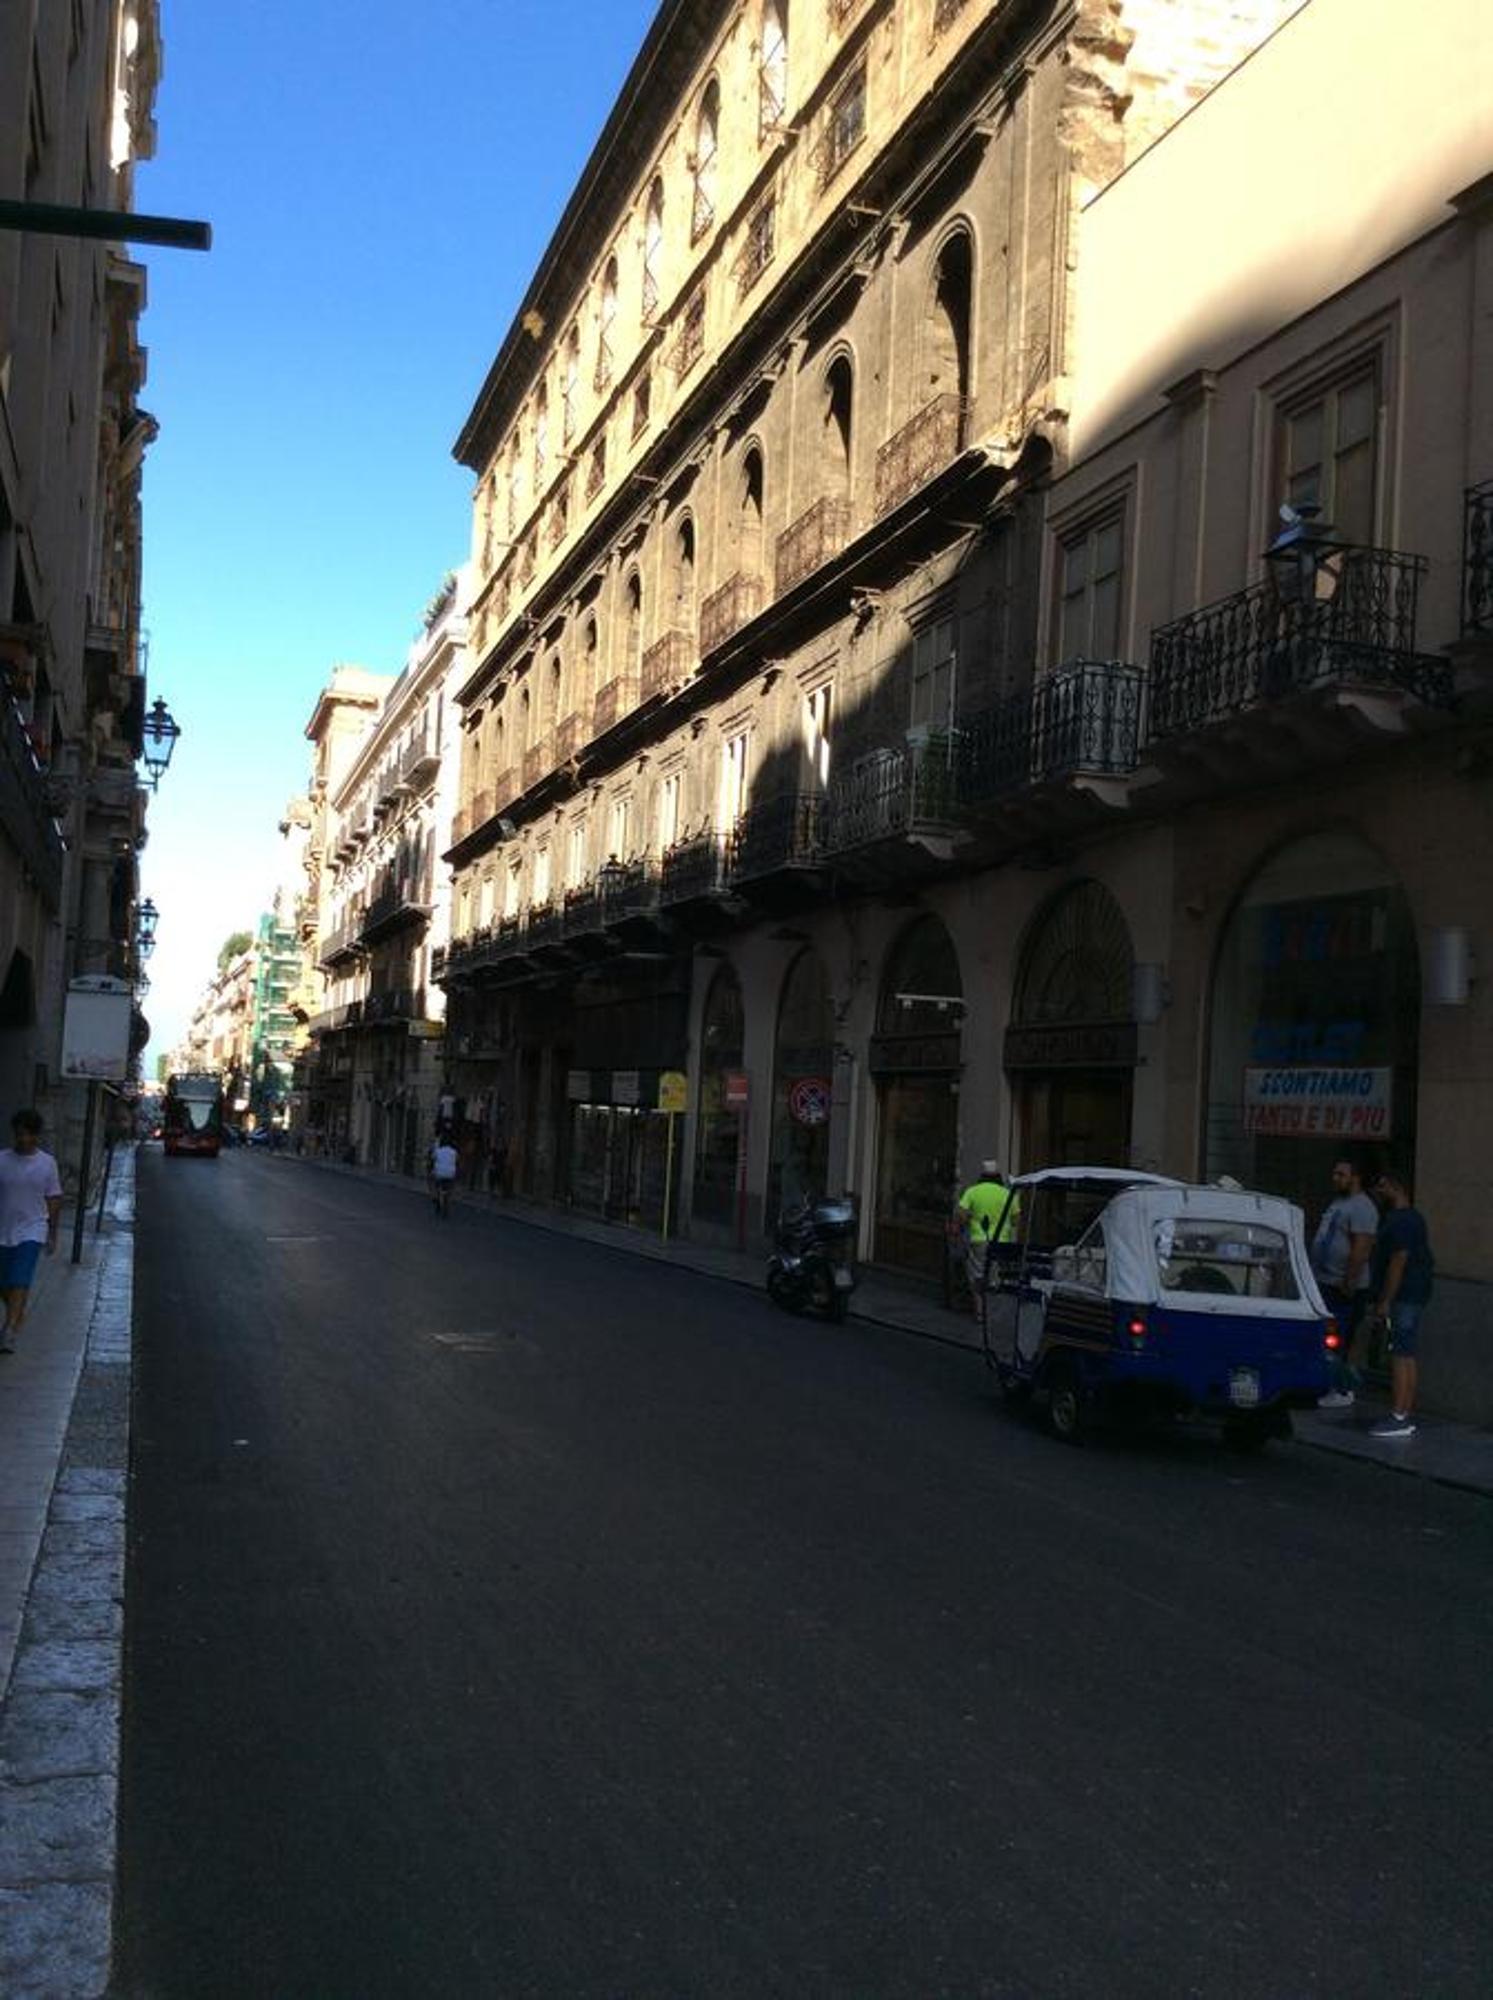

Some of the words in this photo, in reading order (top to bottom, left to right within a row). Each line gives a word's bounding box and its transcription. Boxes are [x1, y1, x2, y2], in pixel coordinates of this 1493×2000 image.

[1261, 1071, 1374, 1095] SCONTIAMO
[1247, 1103, 1302, 1131] TANTO
[1306, 1104, 1318, 1129] E
[1324, 1104, 1345, 1130] DI
